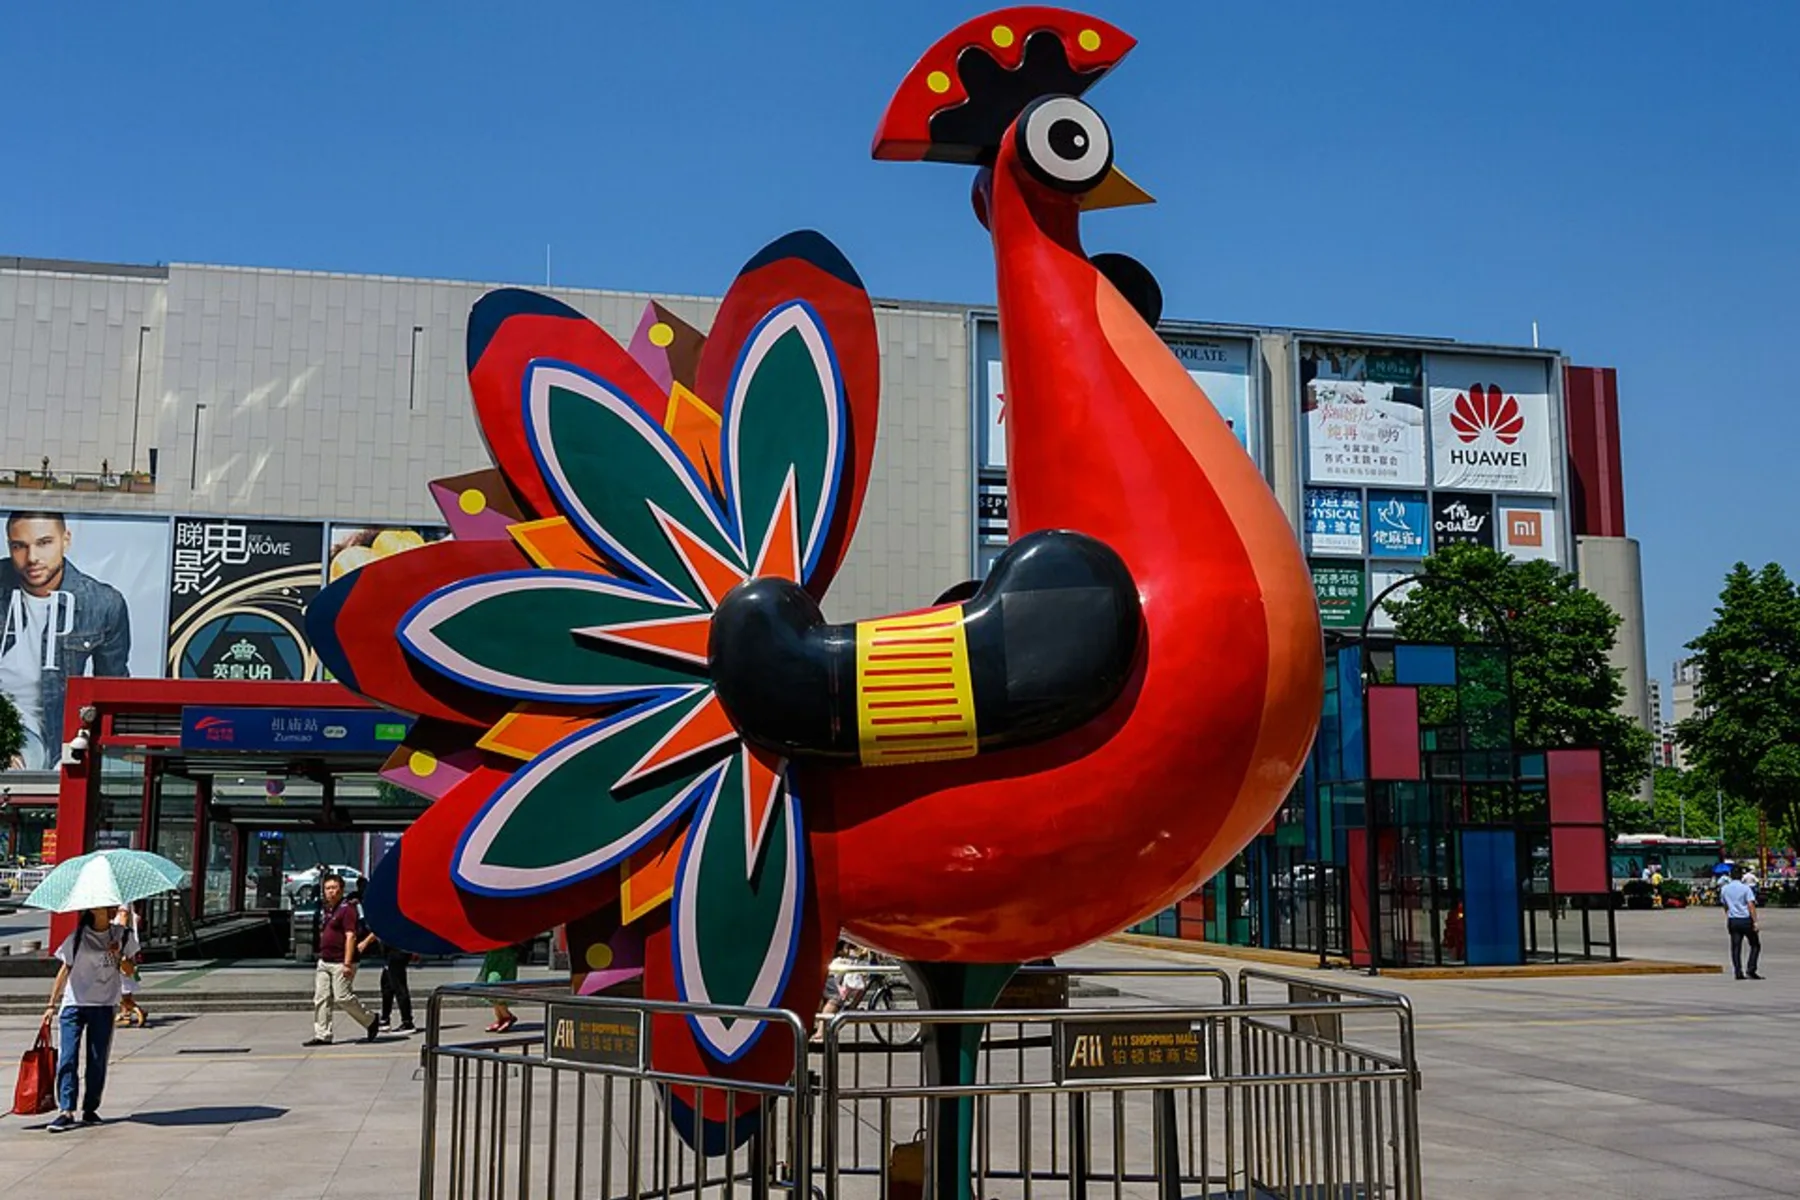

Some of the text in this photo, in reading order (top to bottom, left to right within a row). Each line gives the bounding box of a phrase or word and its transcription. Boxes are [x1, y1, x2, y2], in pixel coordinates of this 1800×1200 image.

[1171, 347, 1227, 361] OOLATE
[1451, 450, 1527, 467] HUAWEI
[248, 542, 291, 555] MOVIE
[1112, 1033, 1199, 1046] A11 SHOPPING MALL
